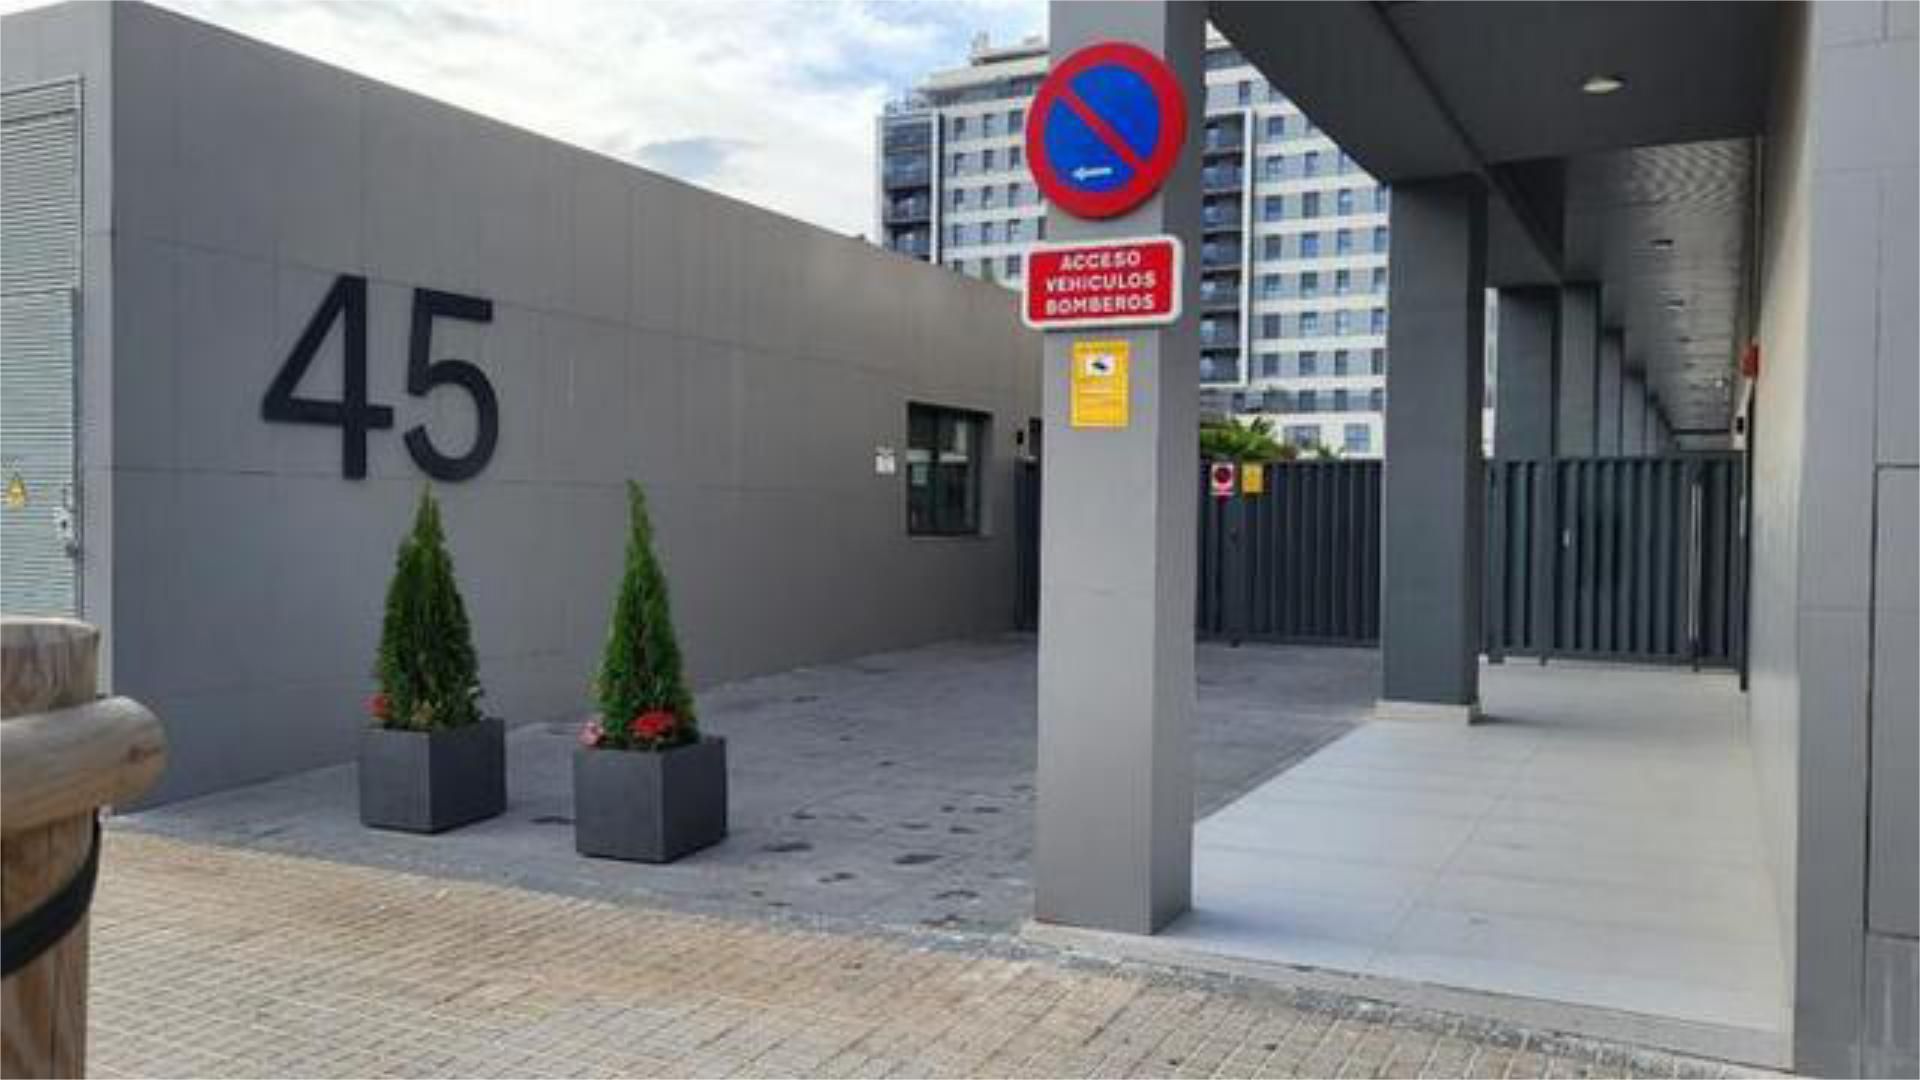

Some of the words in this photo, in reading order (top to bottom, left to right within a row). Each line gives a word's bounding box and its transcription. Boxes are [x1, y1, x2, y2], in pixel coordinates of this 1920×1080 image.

[1060, 250, 1141, 271] ACCESO
[1046, 269, 1156, 292] VEHICULOS
[1045, 294, 1155, 316] BOMBEROS
[262, 273, 499, 482] 45
